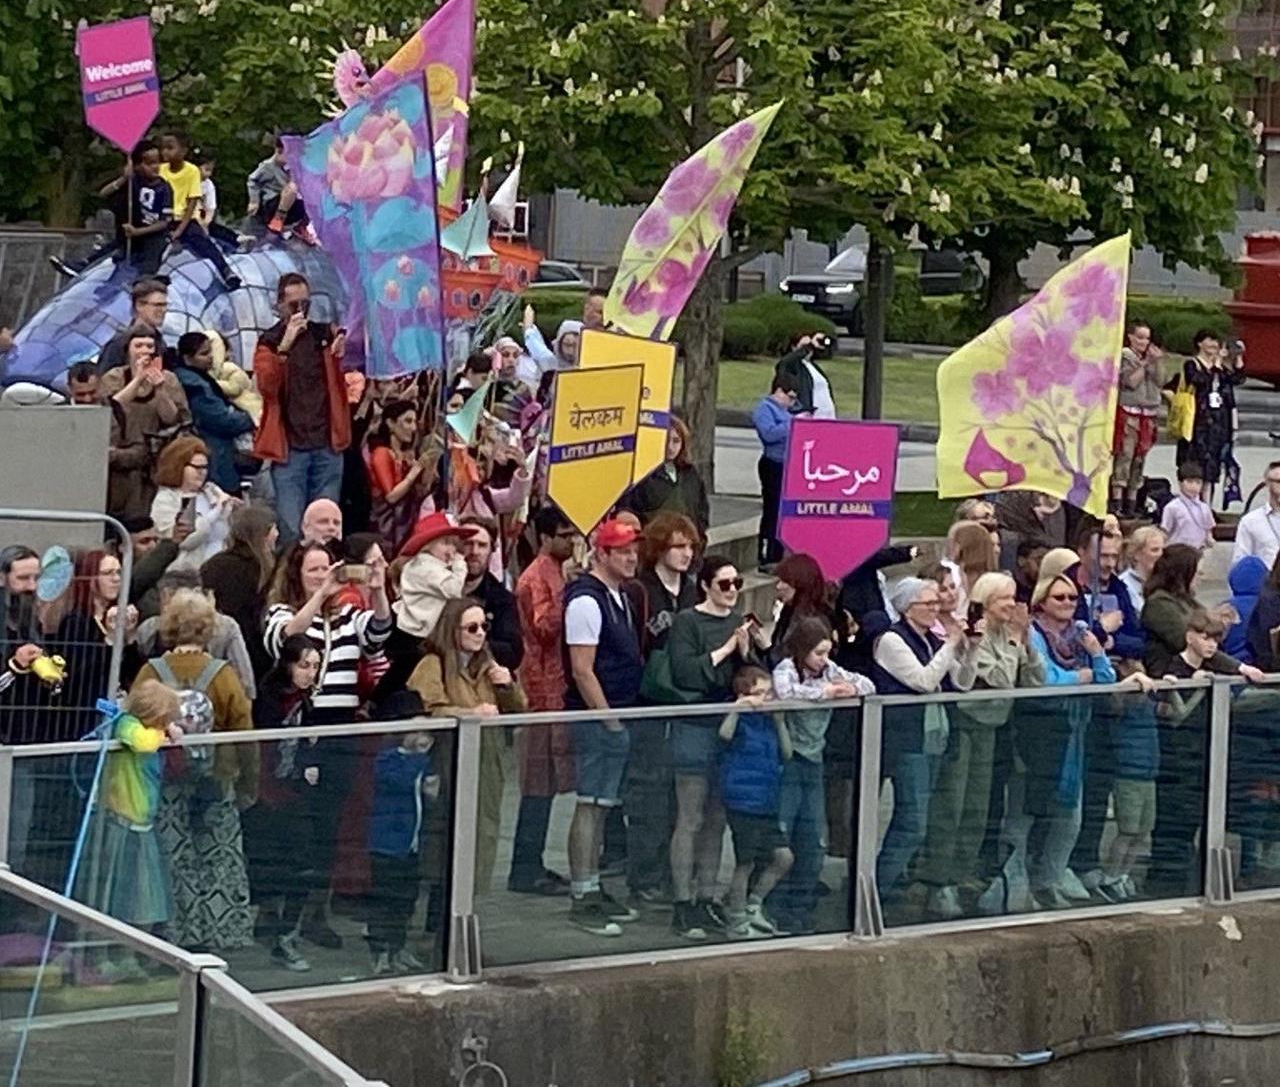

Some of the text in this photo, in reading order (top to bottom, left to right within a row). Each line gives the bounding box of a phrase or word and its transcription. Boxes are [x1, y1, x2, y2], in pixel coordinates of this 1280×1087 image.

[84, 58, 153, 83] Welcome
[561, 439, 625, 461] LITTLE AMAL
[797, 502, 875, 516] LITTLE AMAL
